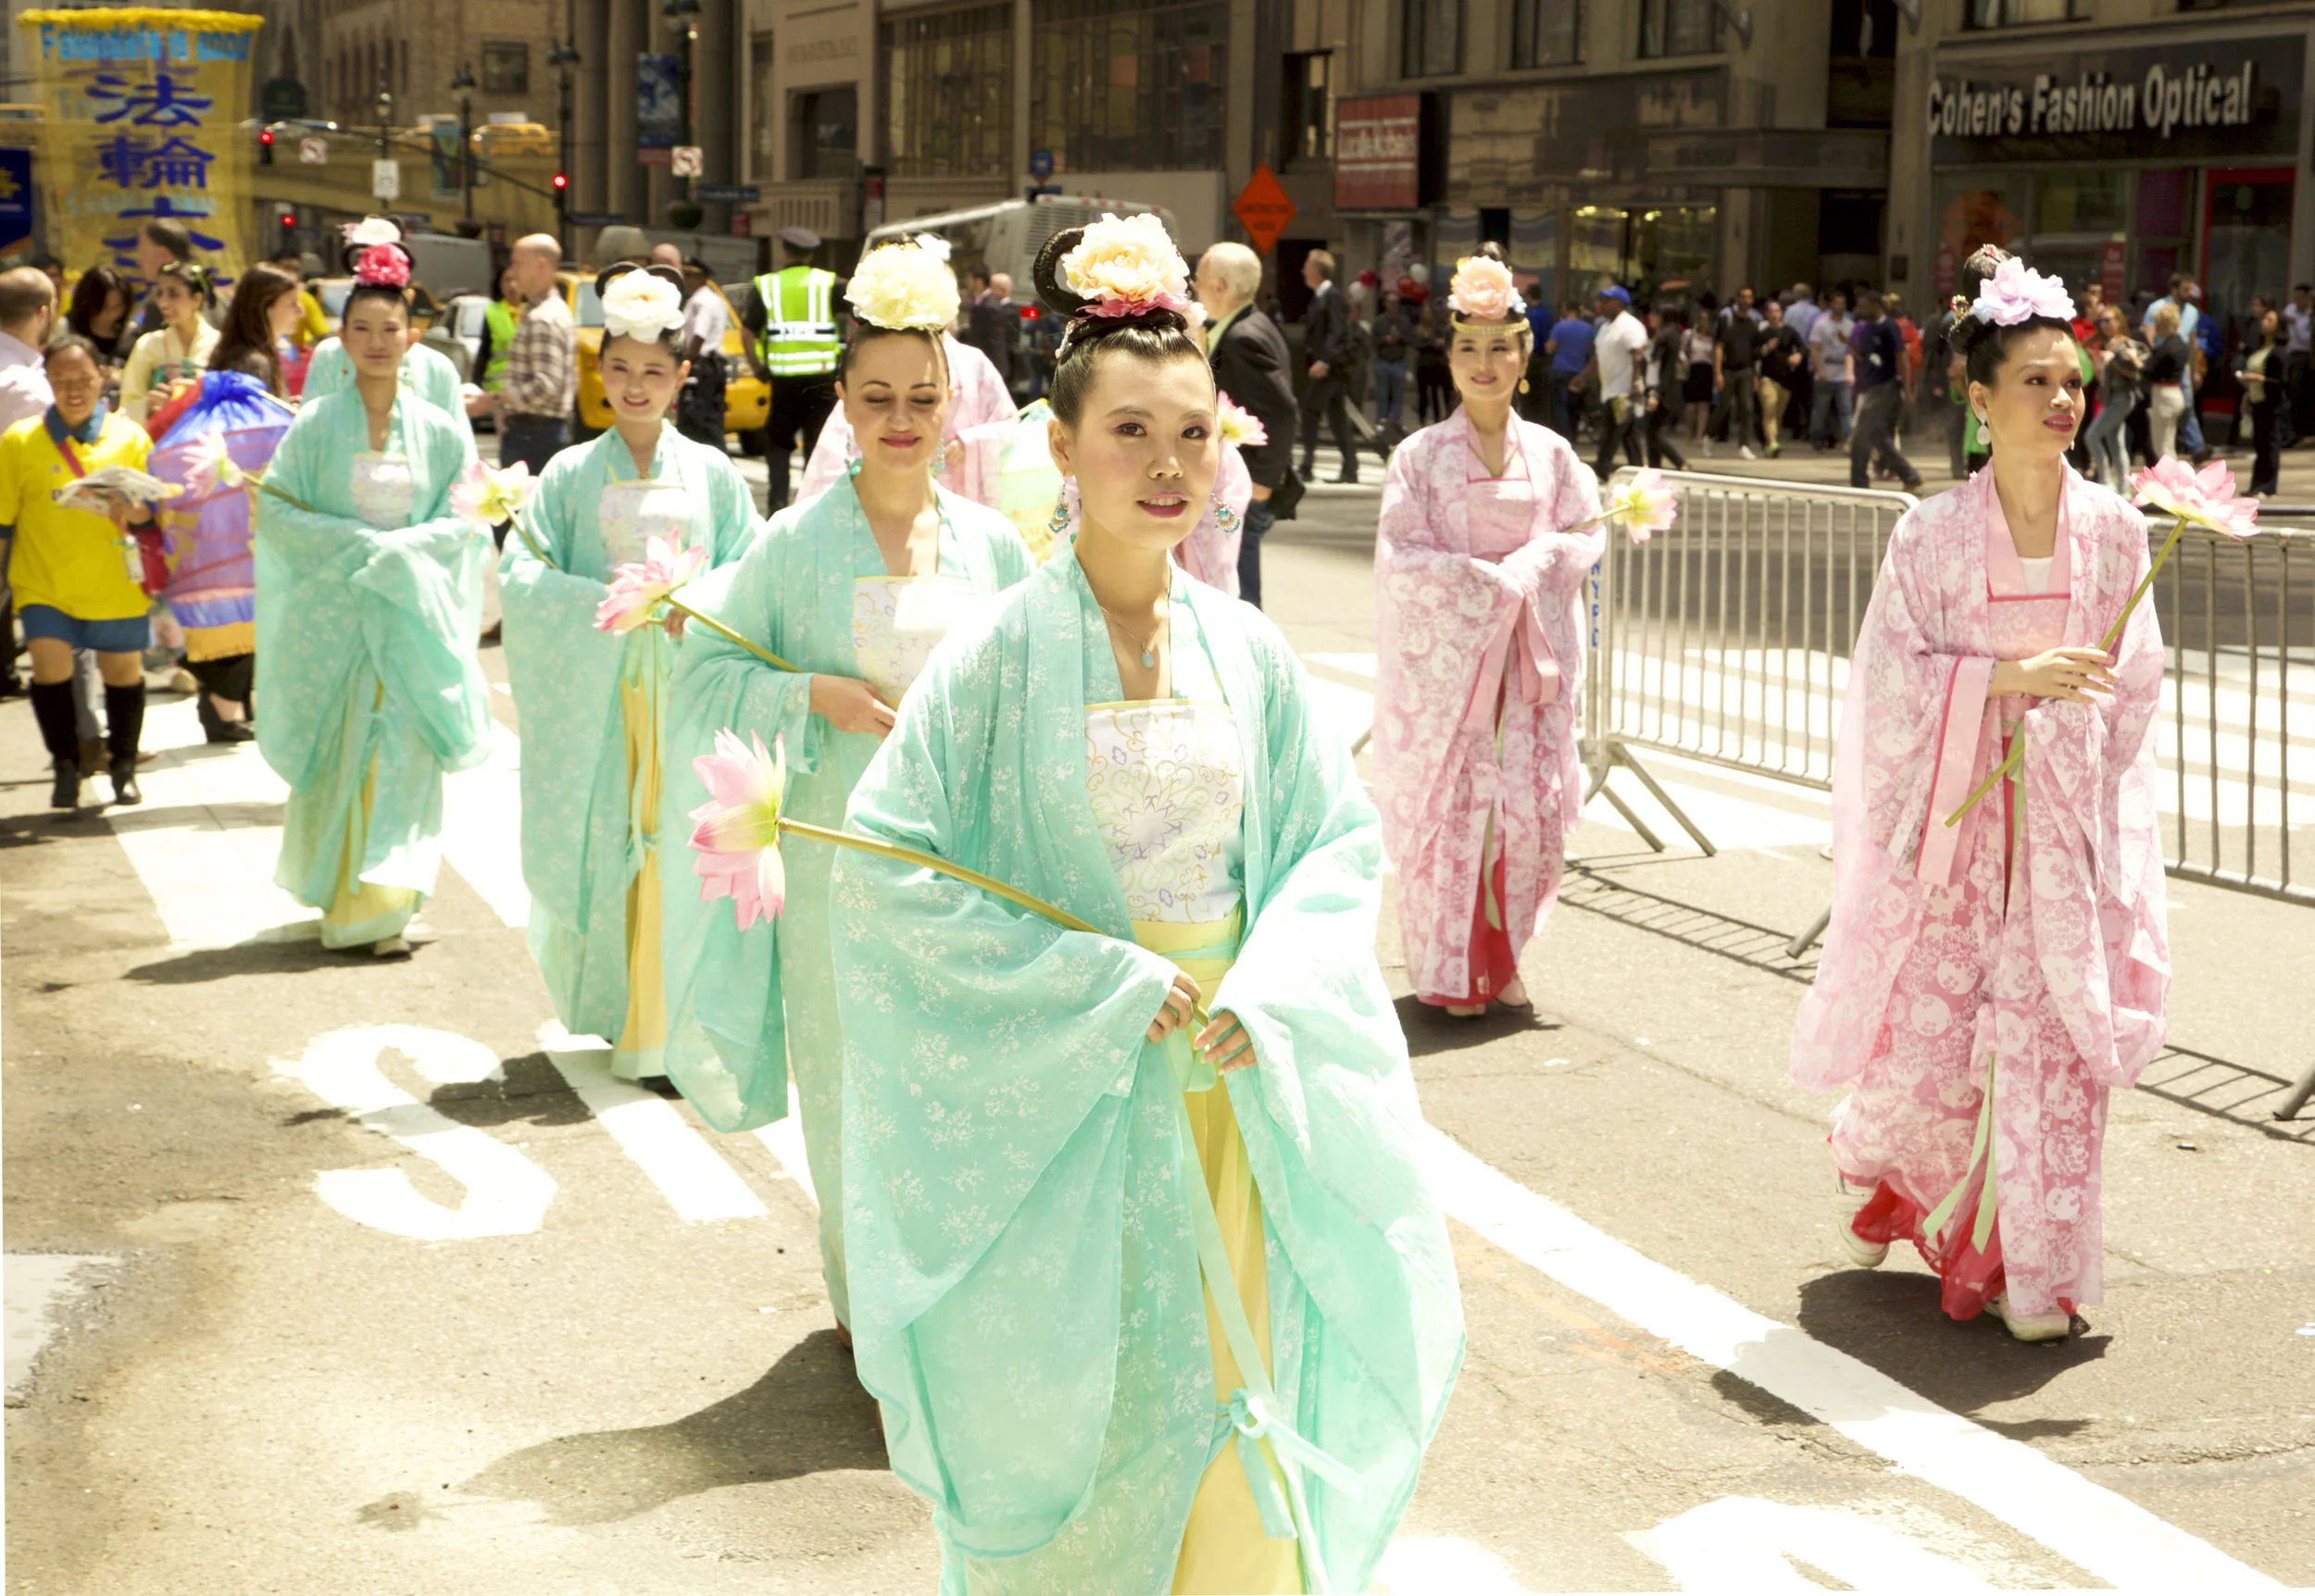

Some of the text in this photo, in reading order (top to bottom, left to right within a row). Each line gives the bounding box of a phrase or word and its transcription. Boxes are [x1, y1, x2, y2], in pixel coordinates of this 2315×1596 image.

[1927, 59, 2254, 139] Cohen's Fashion Optical
